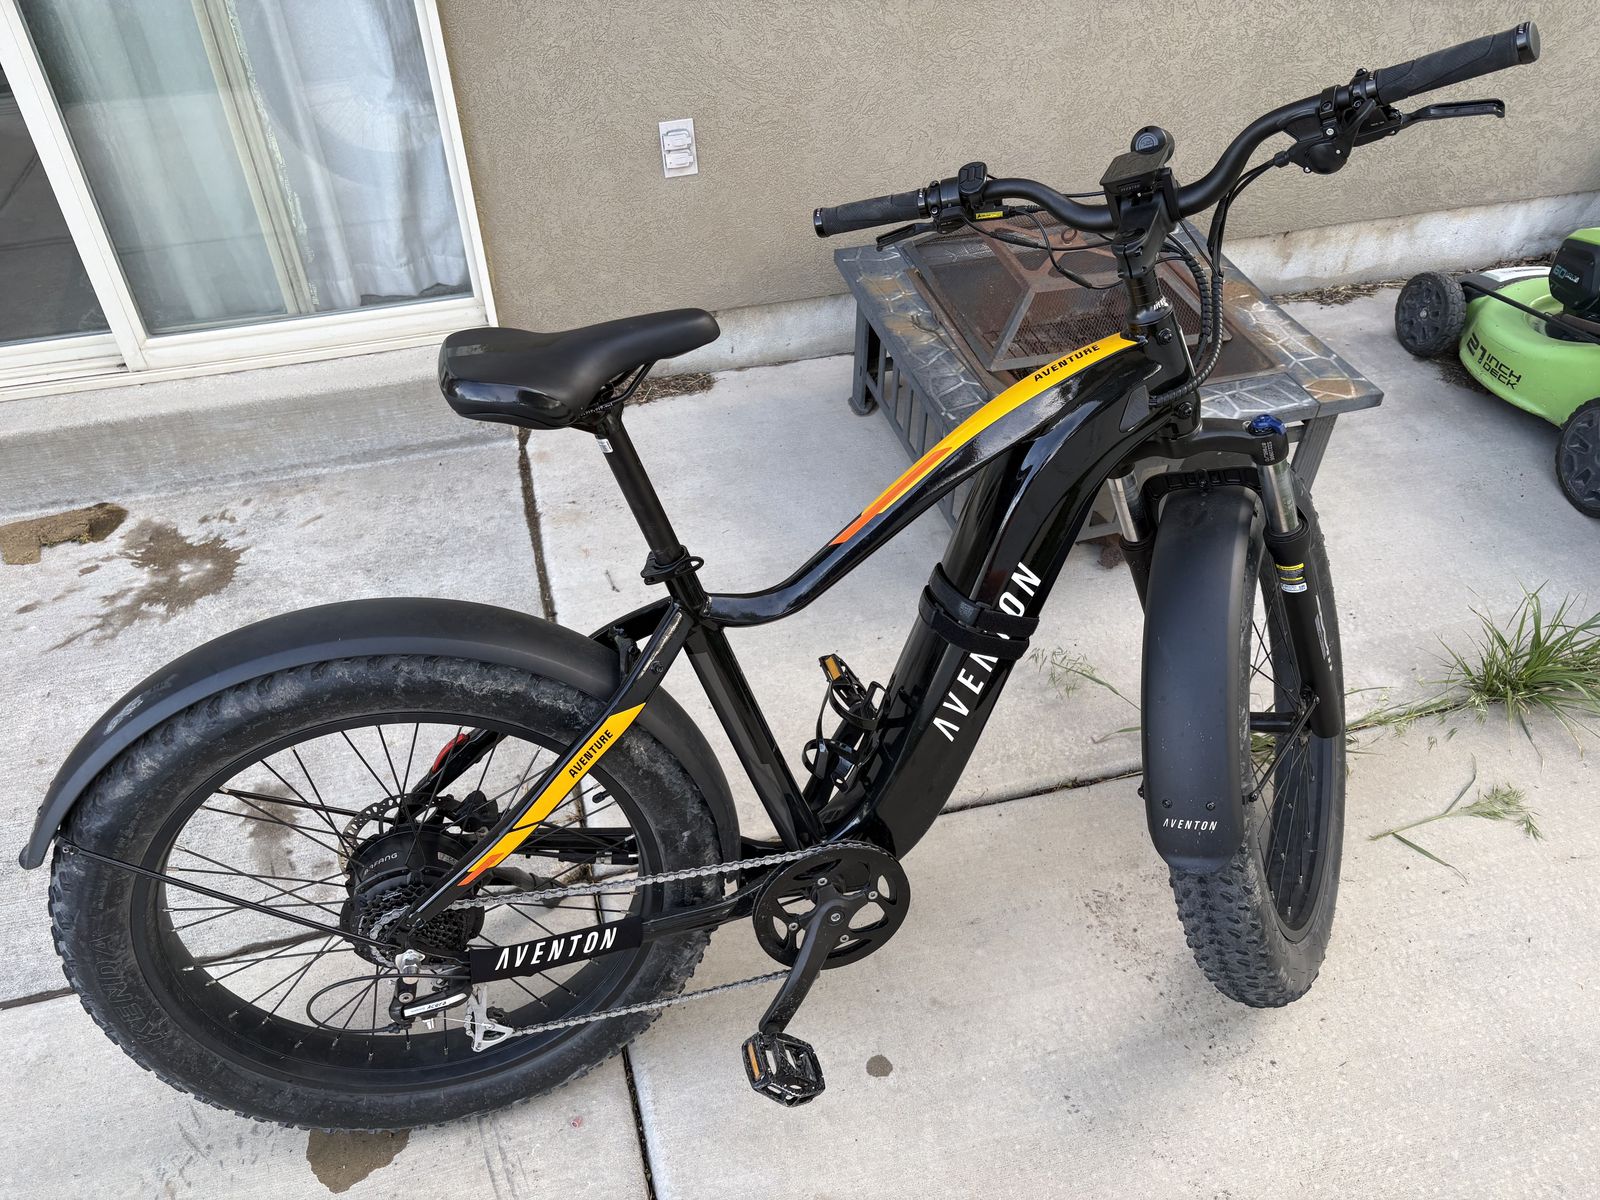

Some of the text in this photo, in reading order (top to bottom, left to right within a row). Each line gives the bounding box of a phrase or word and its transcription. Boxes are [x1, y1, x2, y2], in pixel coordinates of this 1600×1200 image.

[1034, 344, 1101, 382] AVENTURE
[1466, 332, 1522, 383] 21 INCH
[1482, 362, 1519, 390] DECK
[932, 561, 1042, 742] AVENON
[568, 729, 613, 778] AVENTURE
[1162, 818, 1218, 831] AVENTON
[494, 927, 618, 971] AVENTON
